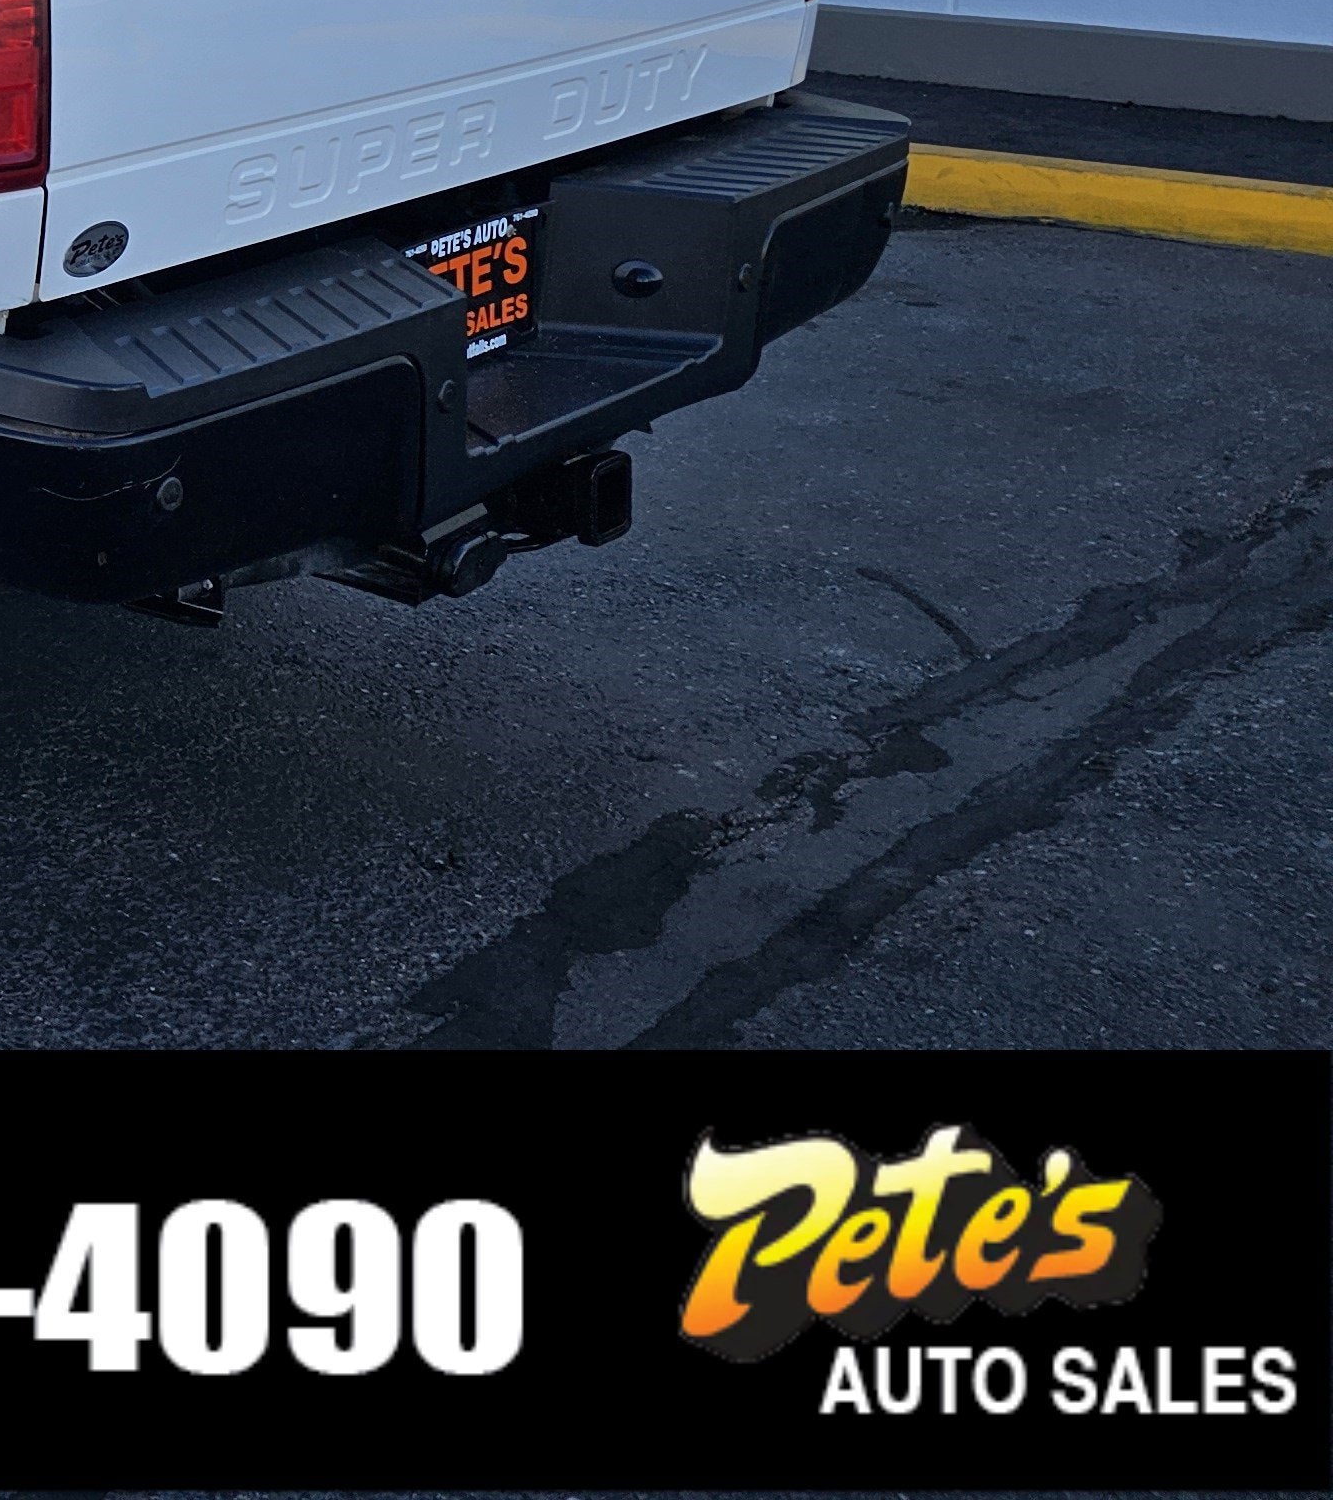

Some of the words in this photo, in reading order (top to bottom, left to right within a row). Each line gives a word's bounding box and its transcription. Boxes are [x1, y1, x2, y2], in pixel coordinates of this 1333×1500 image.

[225, 99, 496, 225] SUPER
[543, 43, 708, 141] DUTY
[431, 228, 471, 258] PETE'S
[473, 217, 508, 245] AUTO
[428, 236, 528, 297] TE'S
[466, 293, 528, 337] SALES
